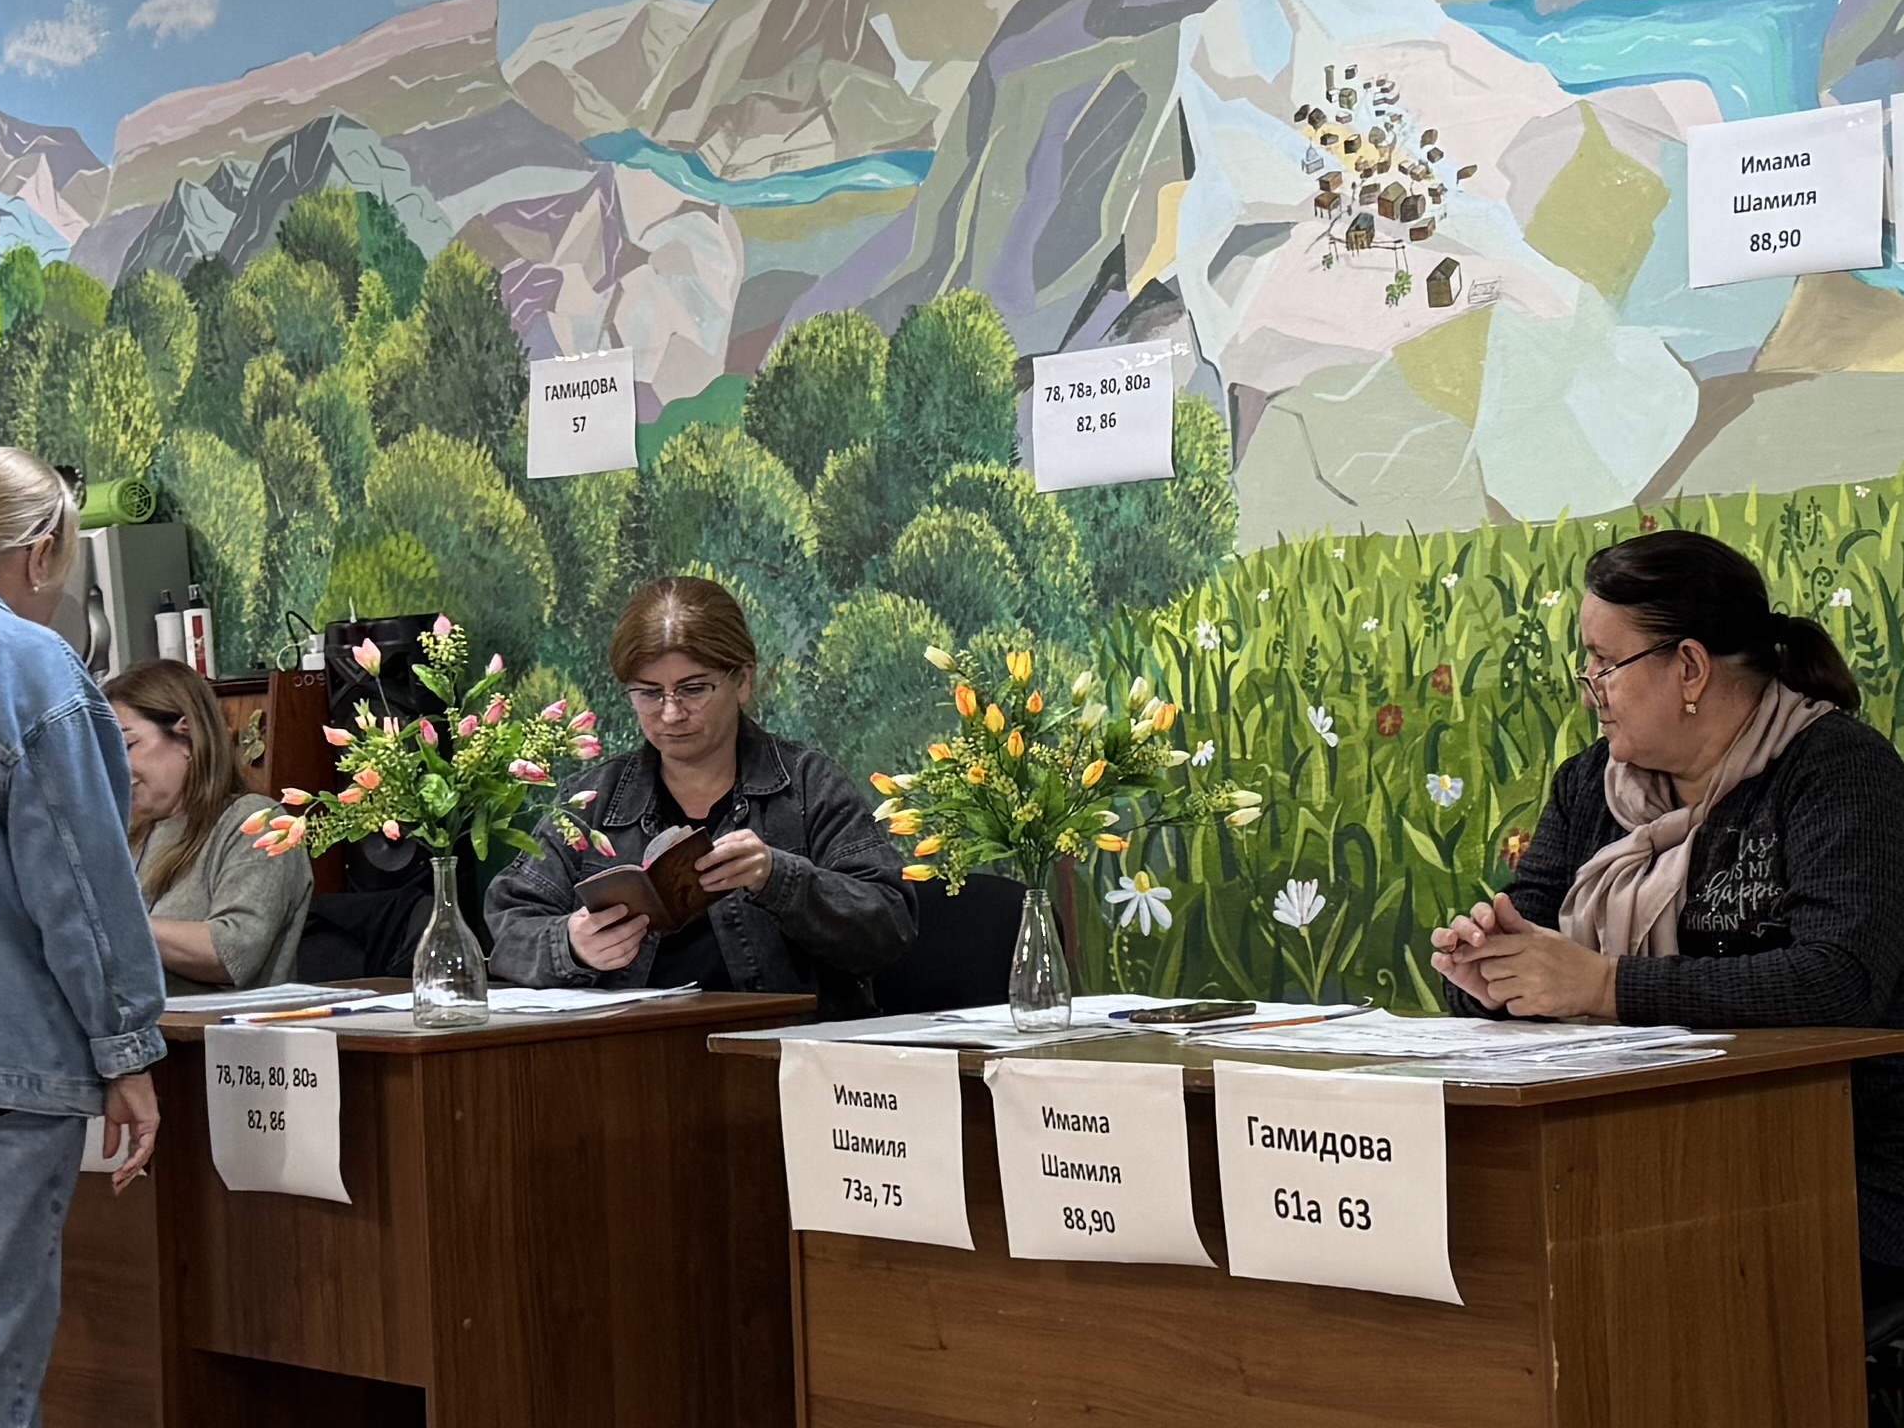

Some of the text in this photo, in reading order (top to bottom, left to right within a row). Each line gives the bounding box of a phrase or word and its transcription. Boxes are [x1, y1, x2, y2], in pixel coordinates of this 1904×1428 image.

[1741, 152, 1811, 175] Имама
[1733, 190, 1817, 214] Шамиля
[1749, 229, 1801, 254] 88,90
[545, 376, 618, 402] ГАМИДОВА
[1044, 374, 1151, 403] 78, 78а, 80, 80а
[572, 415, 587, 433] 57
[1076, 411, 1117, 433] 82, 86
[215, 1064, 318, 1090] 78, 78а, 80, 80а
[833, 1083, 898, 1111] Имама
[247, 1109, 286, 1133] 82, 86
[1041, 1105, 1110, 1134] Имама
[832, 1128, 907, 1159] Шамиля
[1247, 1115, 1392, 1165] Гамидова
[1041, 1153, 1122, 1184] Шамиля
[842, 1177, 903, 1208] 73а, 75
[1063, 1206, 1116, 1236] 88,90
[1274, 1187, 1372, 1231] 61а 63
